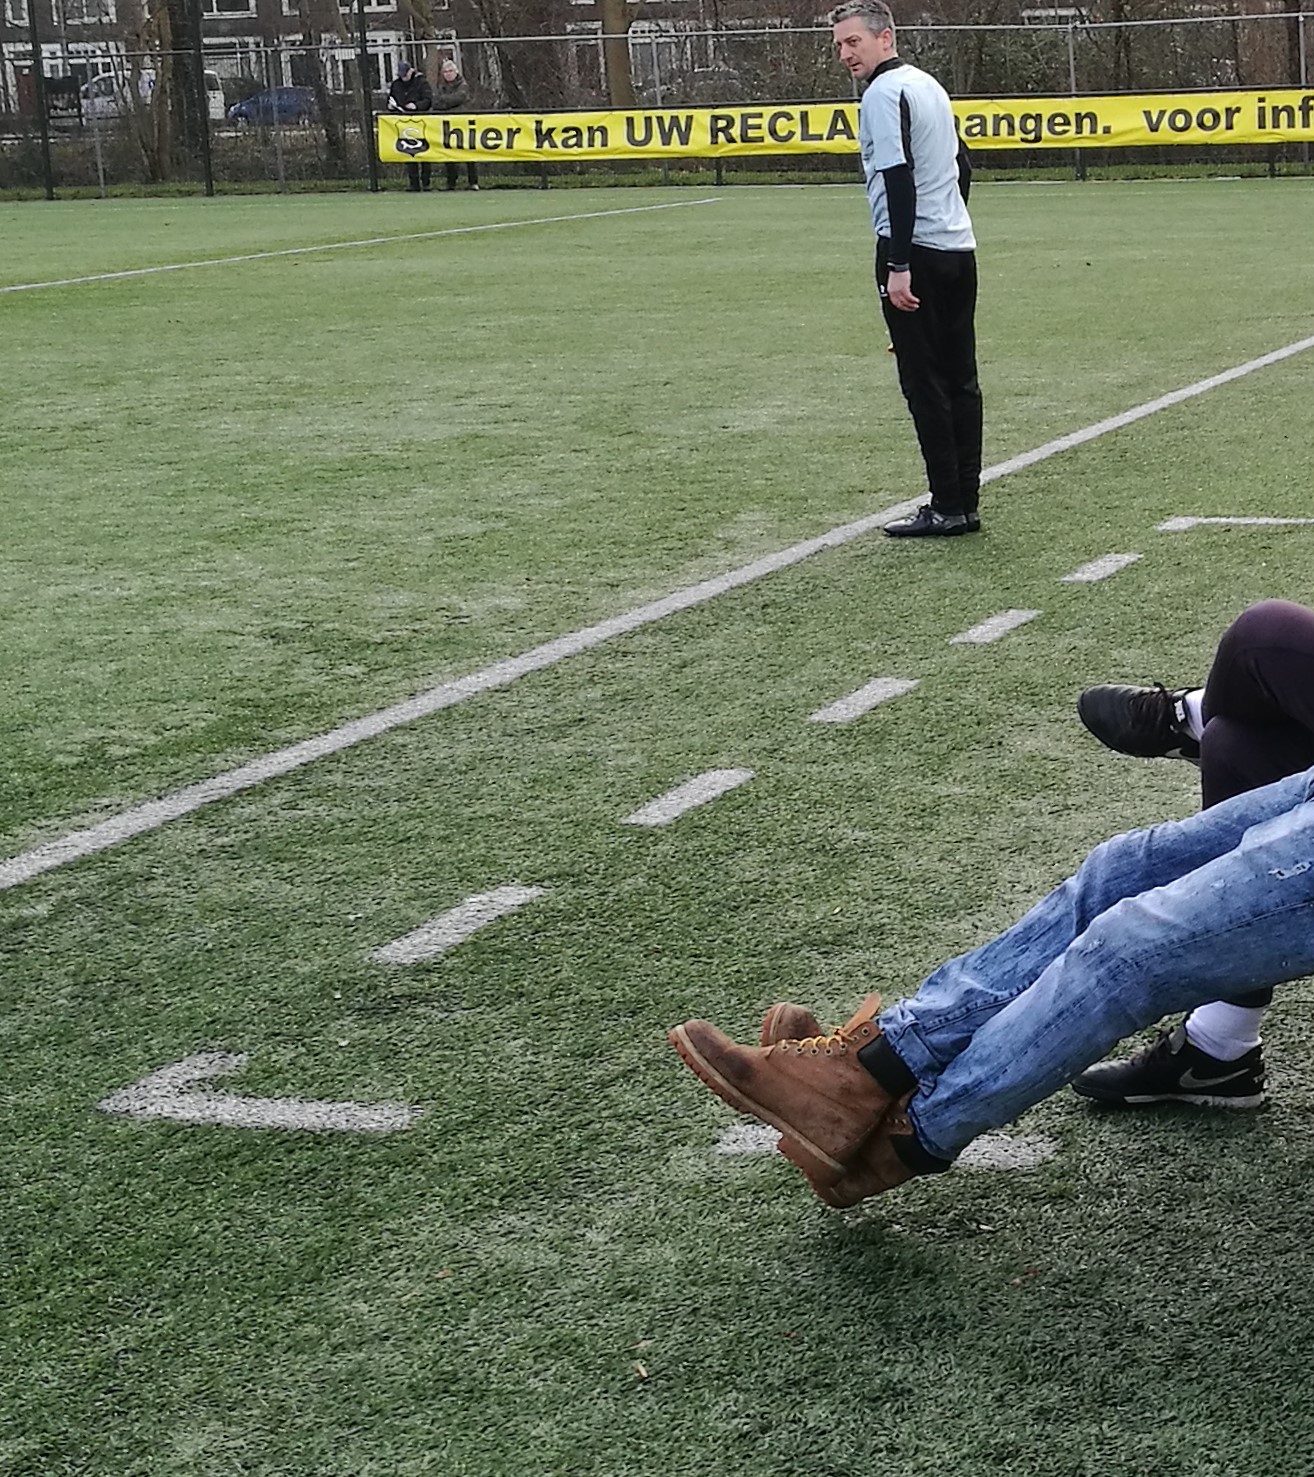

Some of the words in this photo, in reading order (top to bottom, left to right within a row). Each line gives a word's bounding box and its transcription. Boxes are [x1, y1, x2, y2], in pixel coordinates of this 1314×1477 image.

[442, 119, 521, 151] hier
[535, 119, 609, 149] kan
[625, 114, 694, 147] UW
[709, 107, 861, 145] RECLA
[1143, 105, 1242, 134] voor
